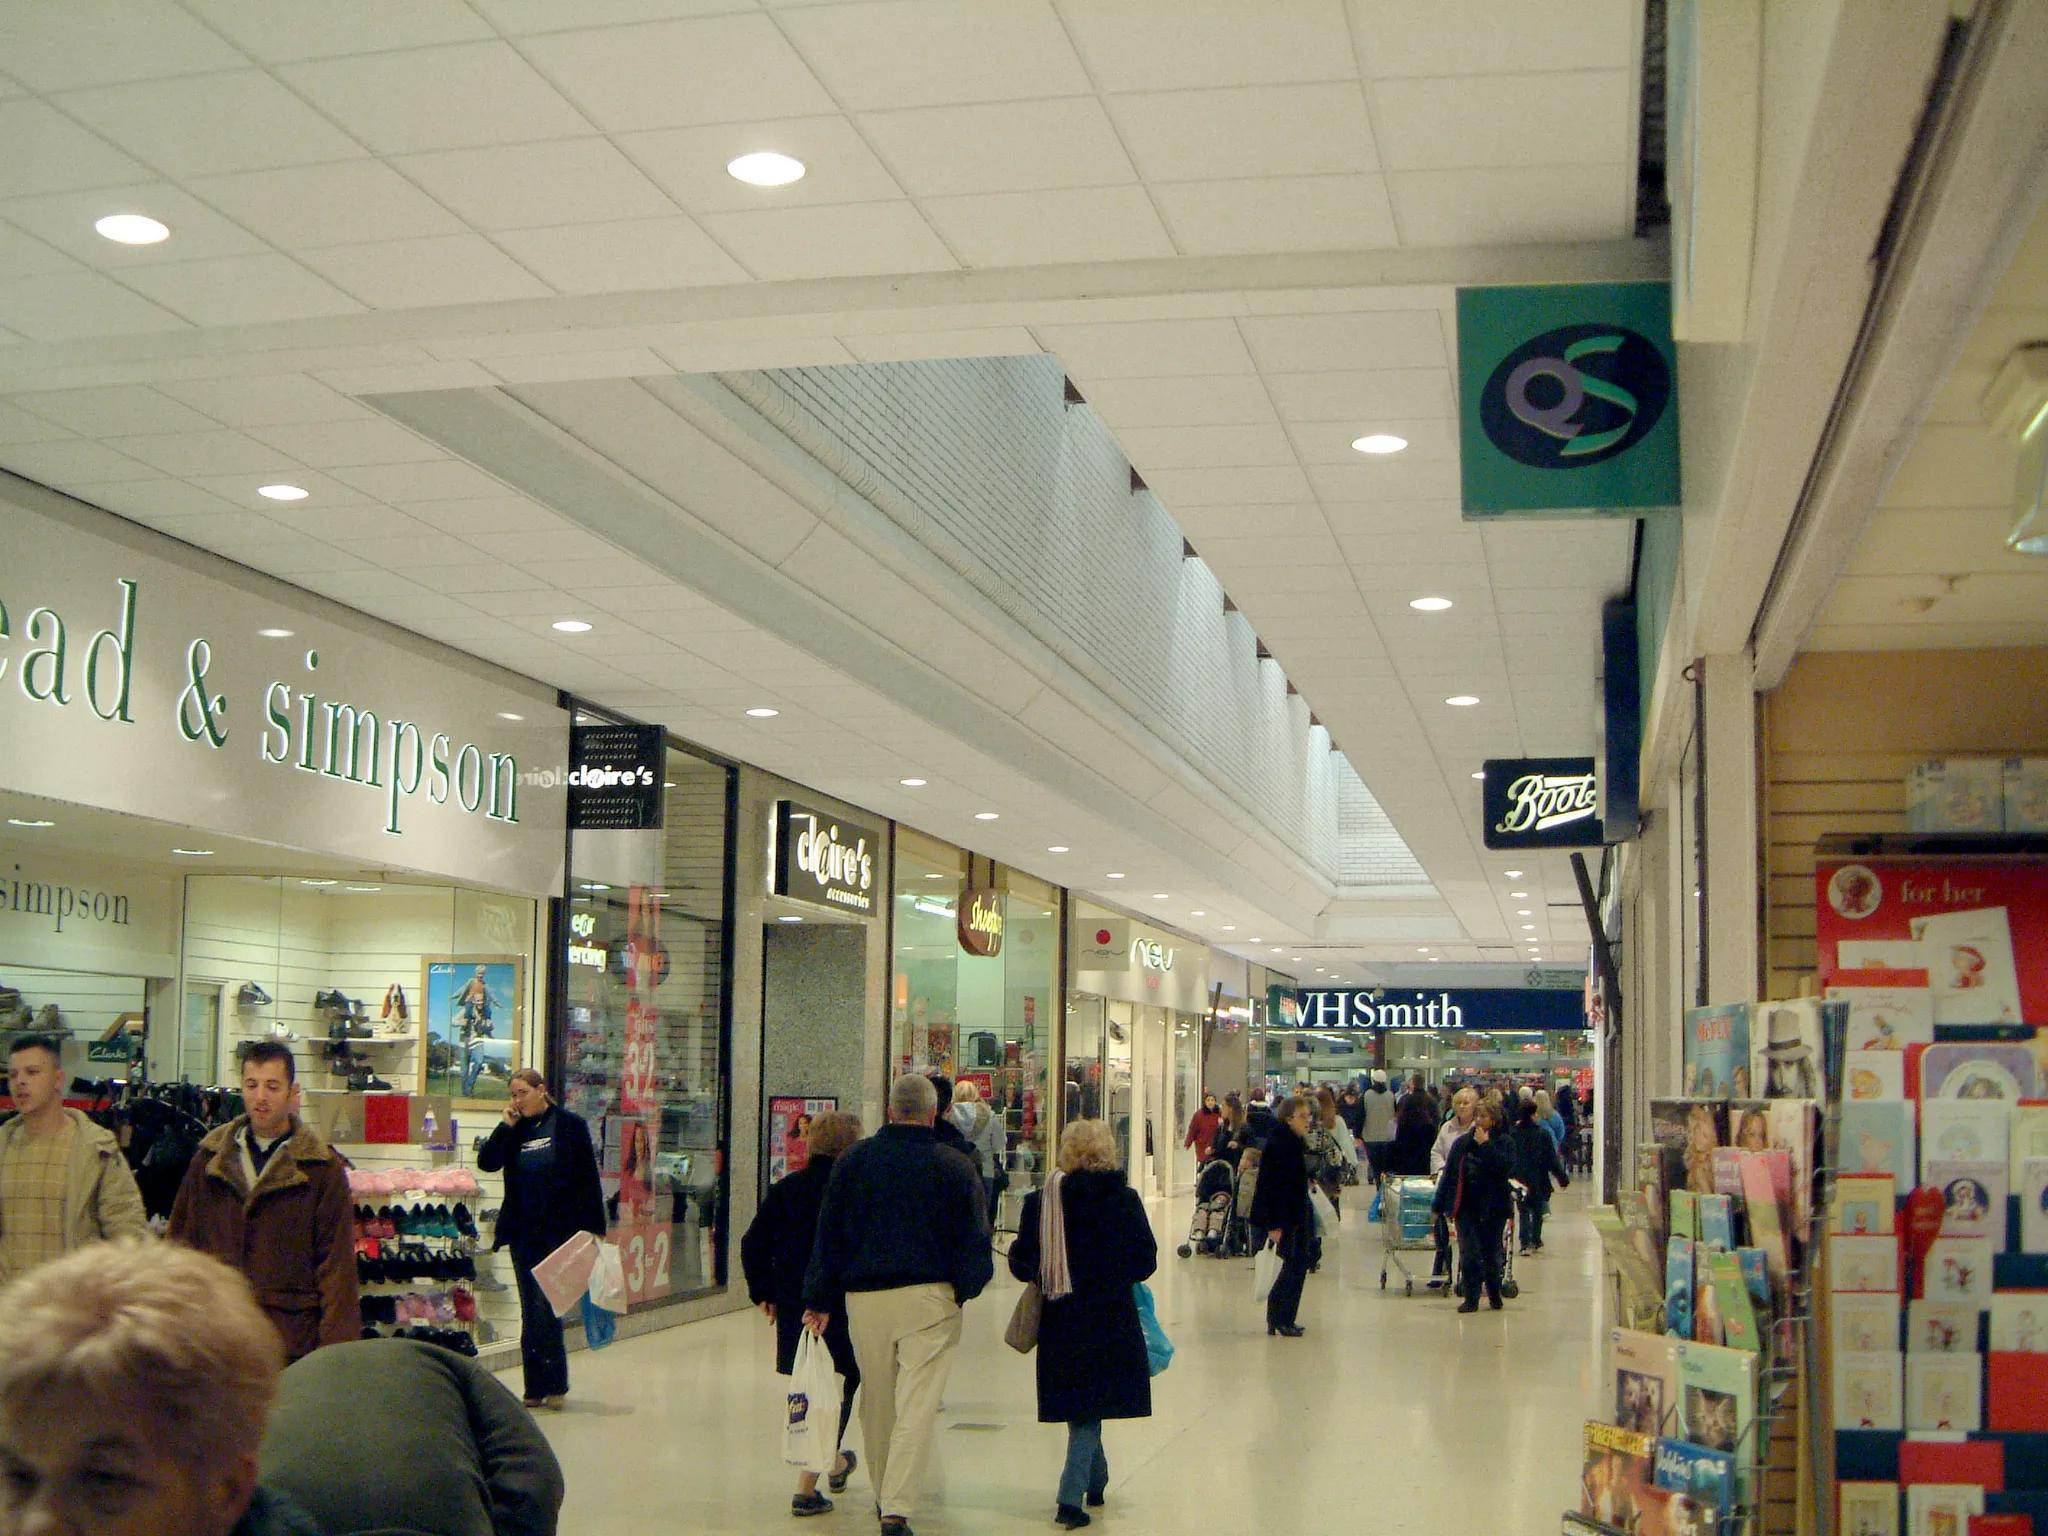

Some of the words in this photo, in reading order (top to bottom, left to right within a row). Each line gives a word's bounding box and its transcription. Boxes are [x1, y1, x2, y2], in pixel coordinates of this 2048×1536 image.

[176, 637, 229, 748] &
[262, 649, 520, 835] simpson
[568, 764, 654, 789] claire's
[797, 815, 872, 890] claire's
[826, 887, 870, 909] accessories
[571, 913, 596, 937] ear
[628, 1235, 644, 1293] 3
[653, 1231, 670, 1288] 2
